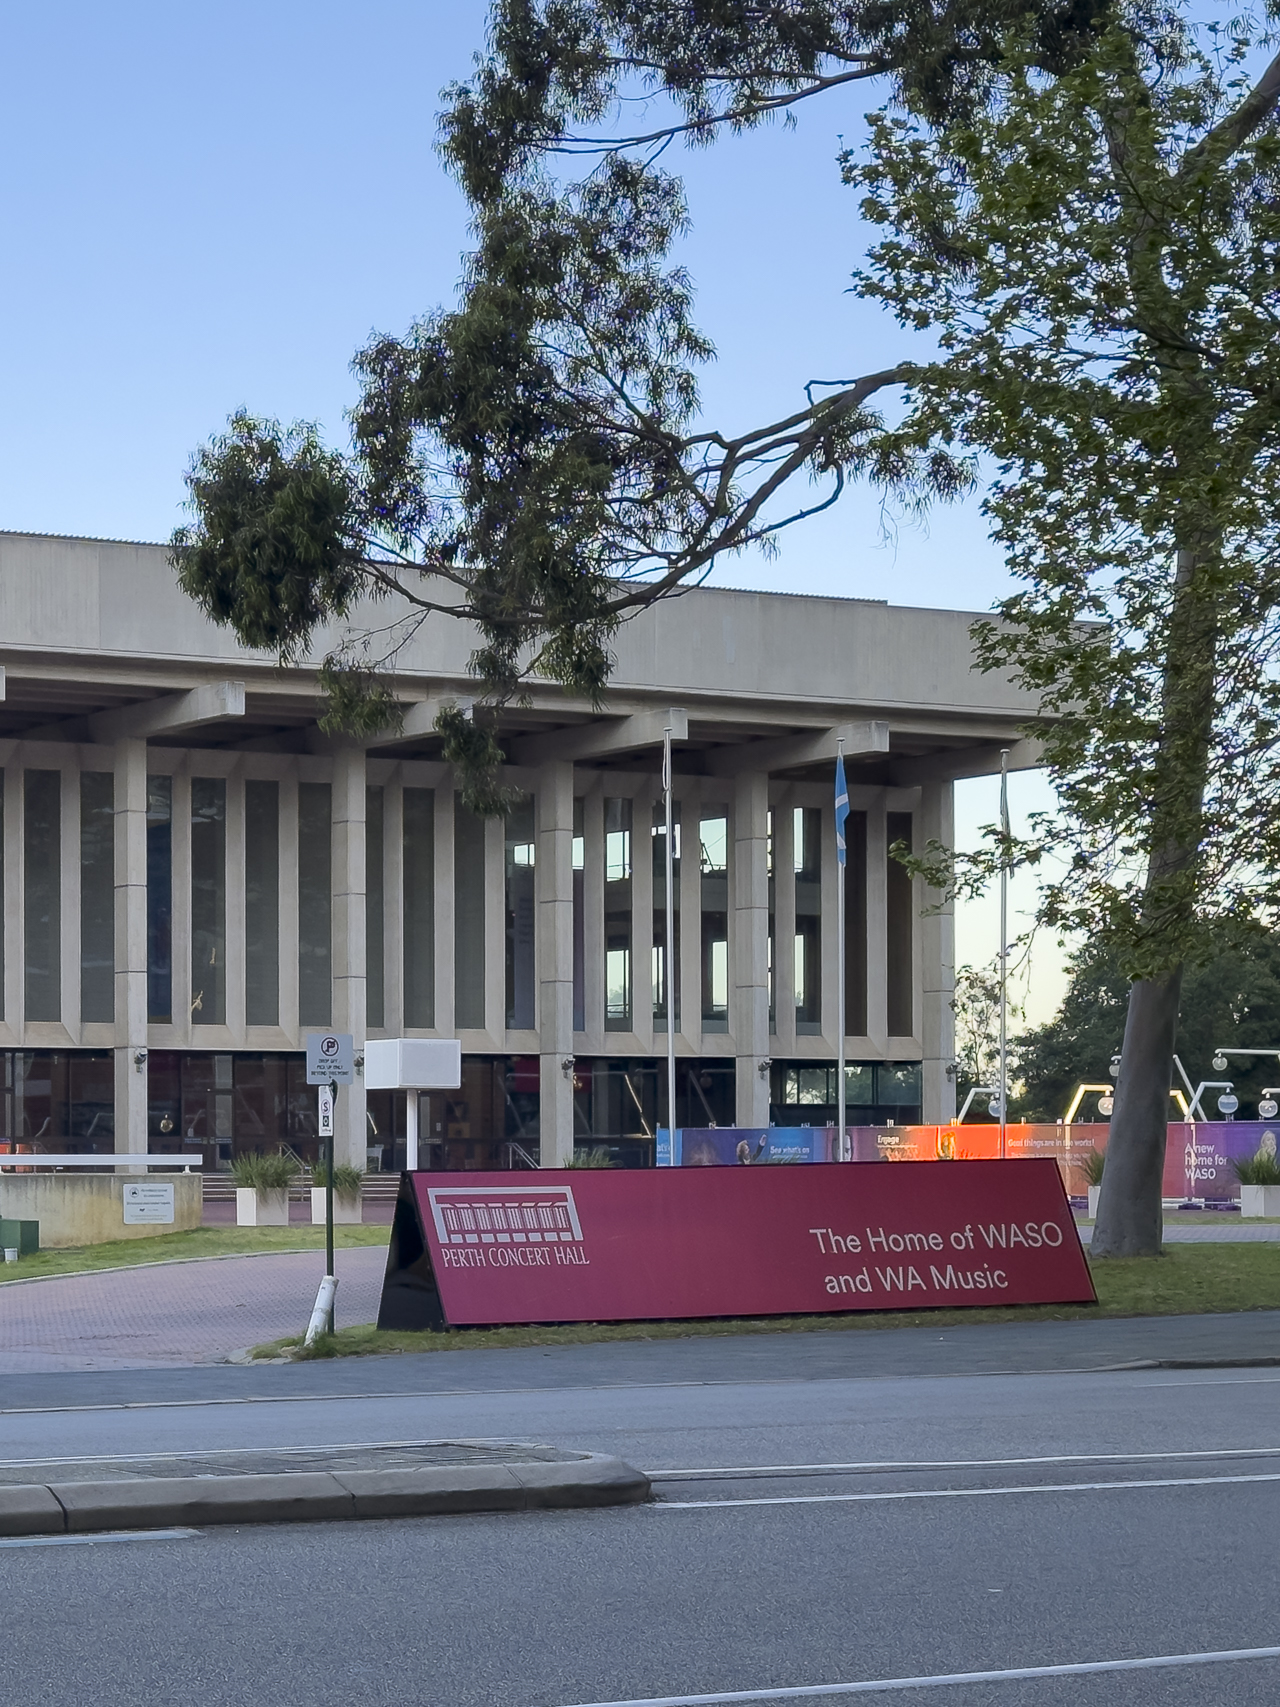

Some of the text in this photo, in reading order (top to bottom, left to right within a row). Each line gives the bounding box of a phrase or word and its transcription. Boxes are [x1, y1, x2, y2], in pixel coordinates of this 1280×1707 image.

[877, 1134, 900, 1145] Engage
[1008, 1138, 1023, 1147] Good
[1023, 1138, 1045, 1149] things
[1055, 1138, 1062, 1147] in
[1074, 1138, 1095, 1147] works!
[770, 1145, 782, 1154] See
[782, 1145, 802, 1154] what's
[1184, 1143, 1215, 1154] A new
[1184, 1153, 1228, 1166] home for
[1184, 1168, 1217, 1180] WASO
[809, 1221, 1063, 1254] The Home of WASO
[441, 1246, 590, 1268] PERTH CONCERT HALL
[824, 1263, 1009, 1294] and WA Music
